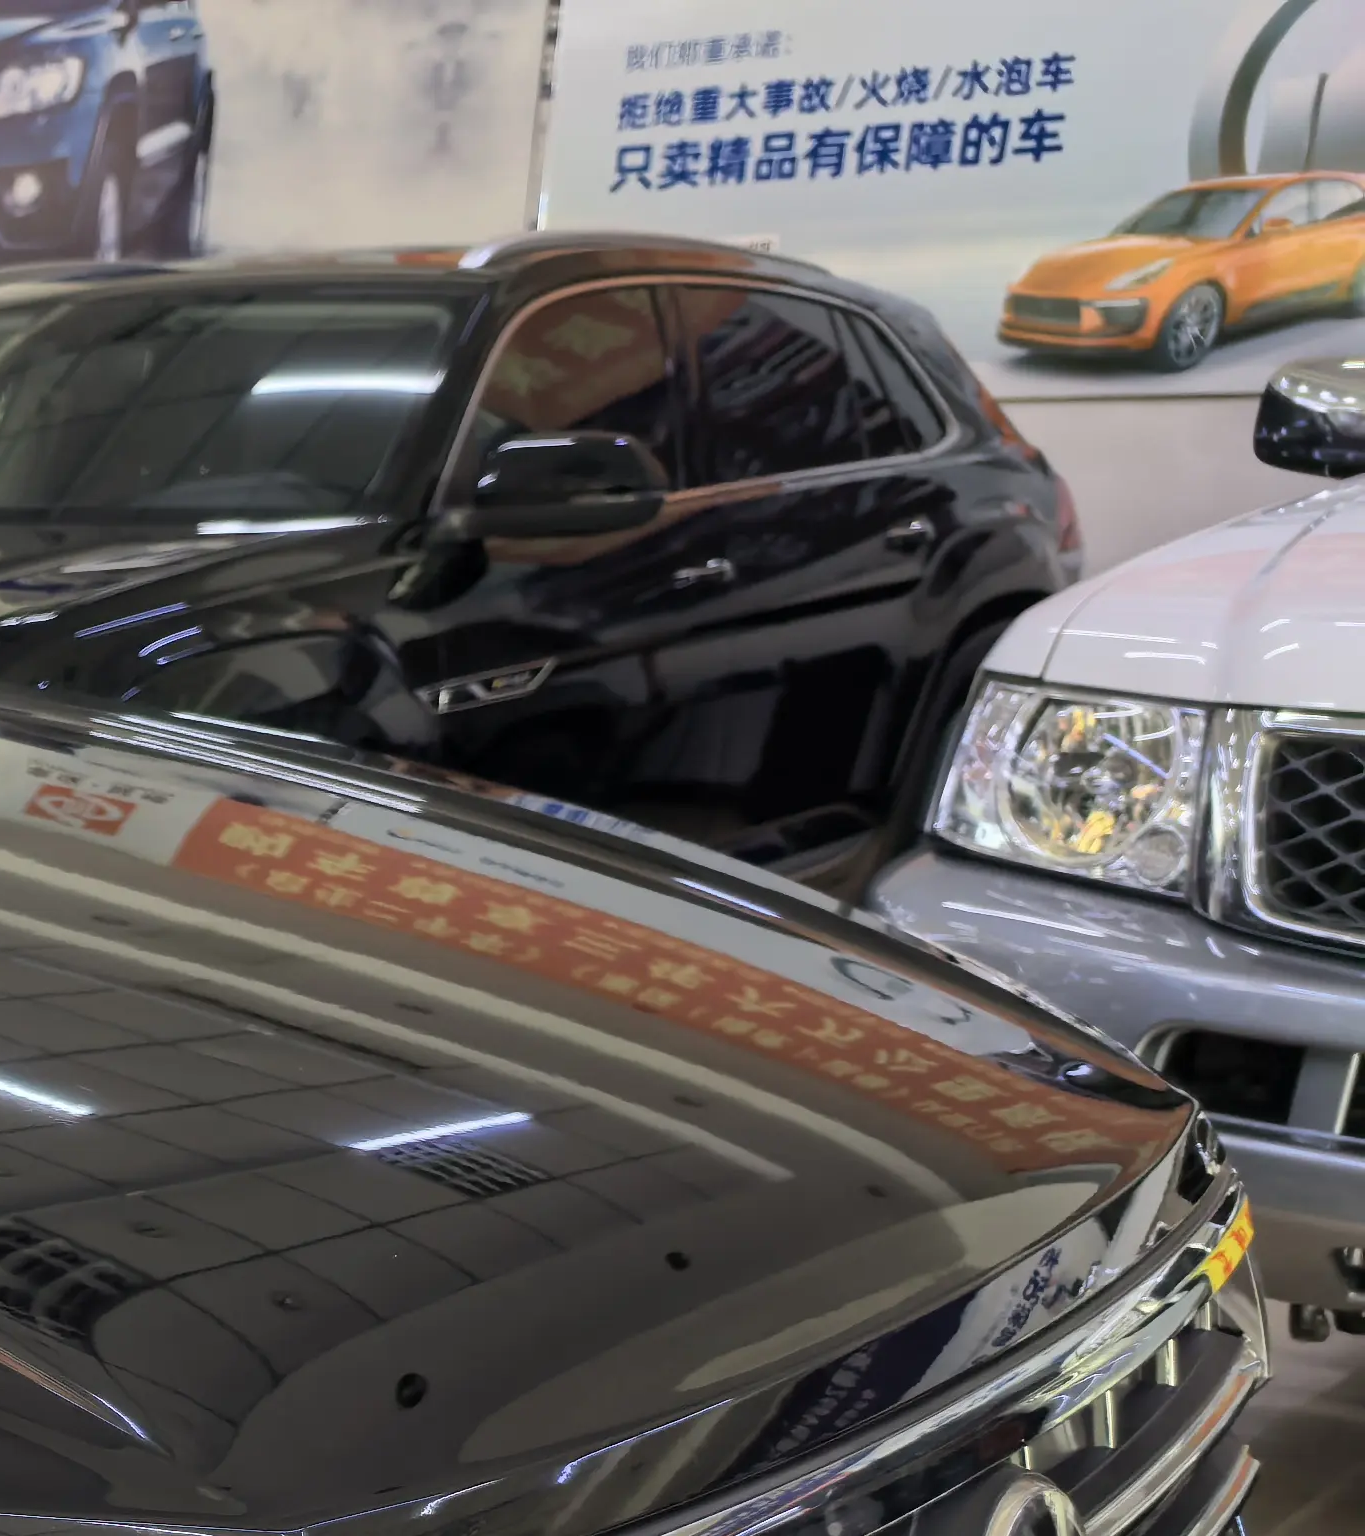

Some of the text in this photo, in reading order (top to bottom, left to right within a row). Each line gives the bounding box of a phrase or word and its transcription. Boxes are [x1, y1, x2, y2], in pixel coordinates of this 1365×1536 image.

[618, 52, 1076, 131] 拒绝重大事故/火烧/水泡车
[609, 108, 1066, 192] 只卖精品有保障的车
